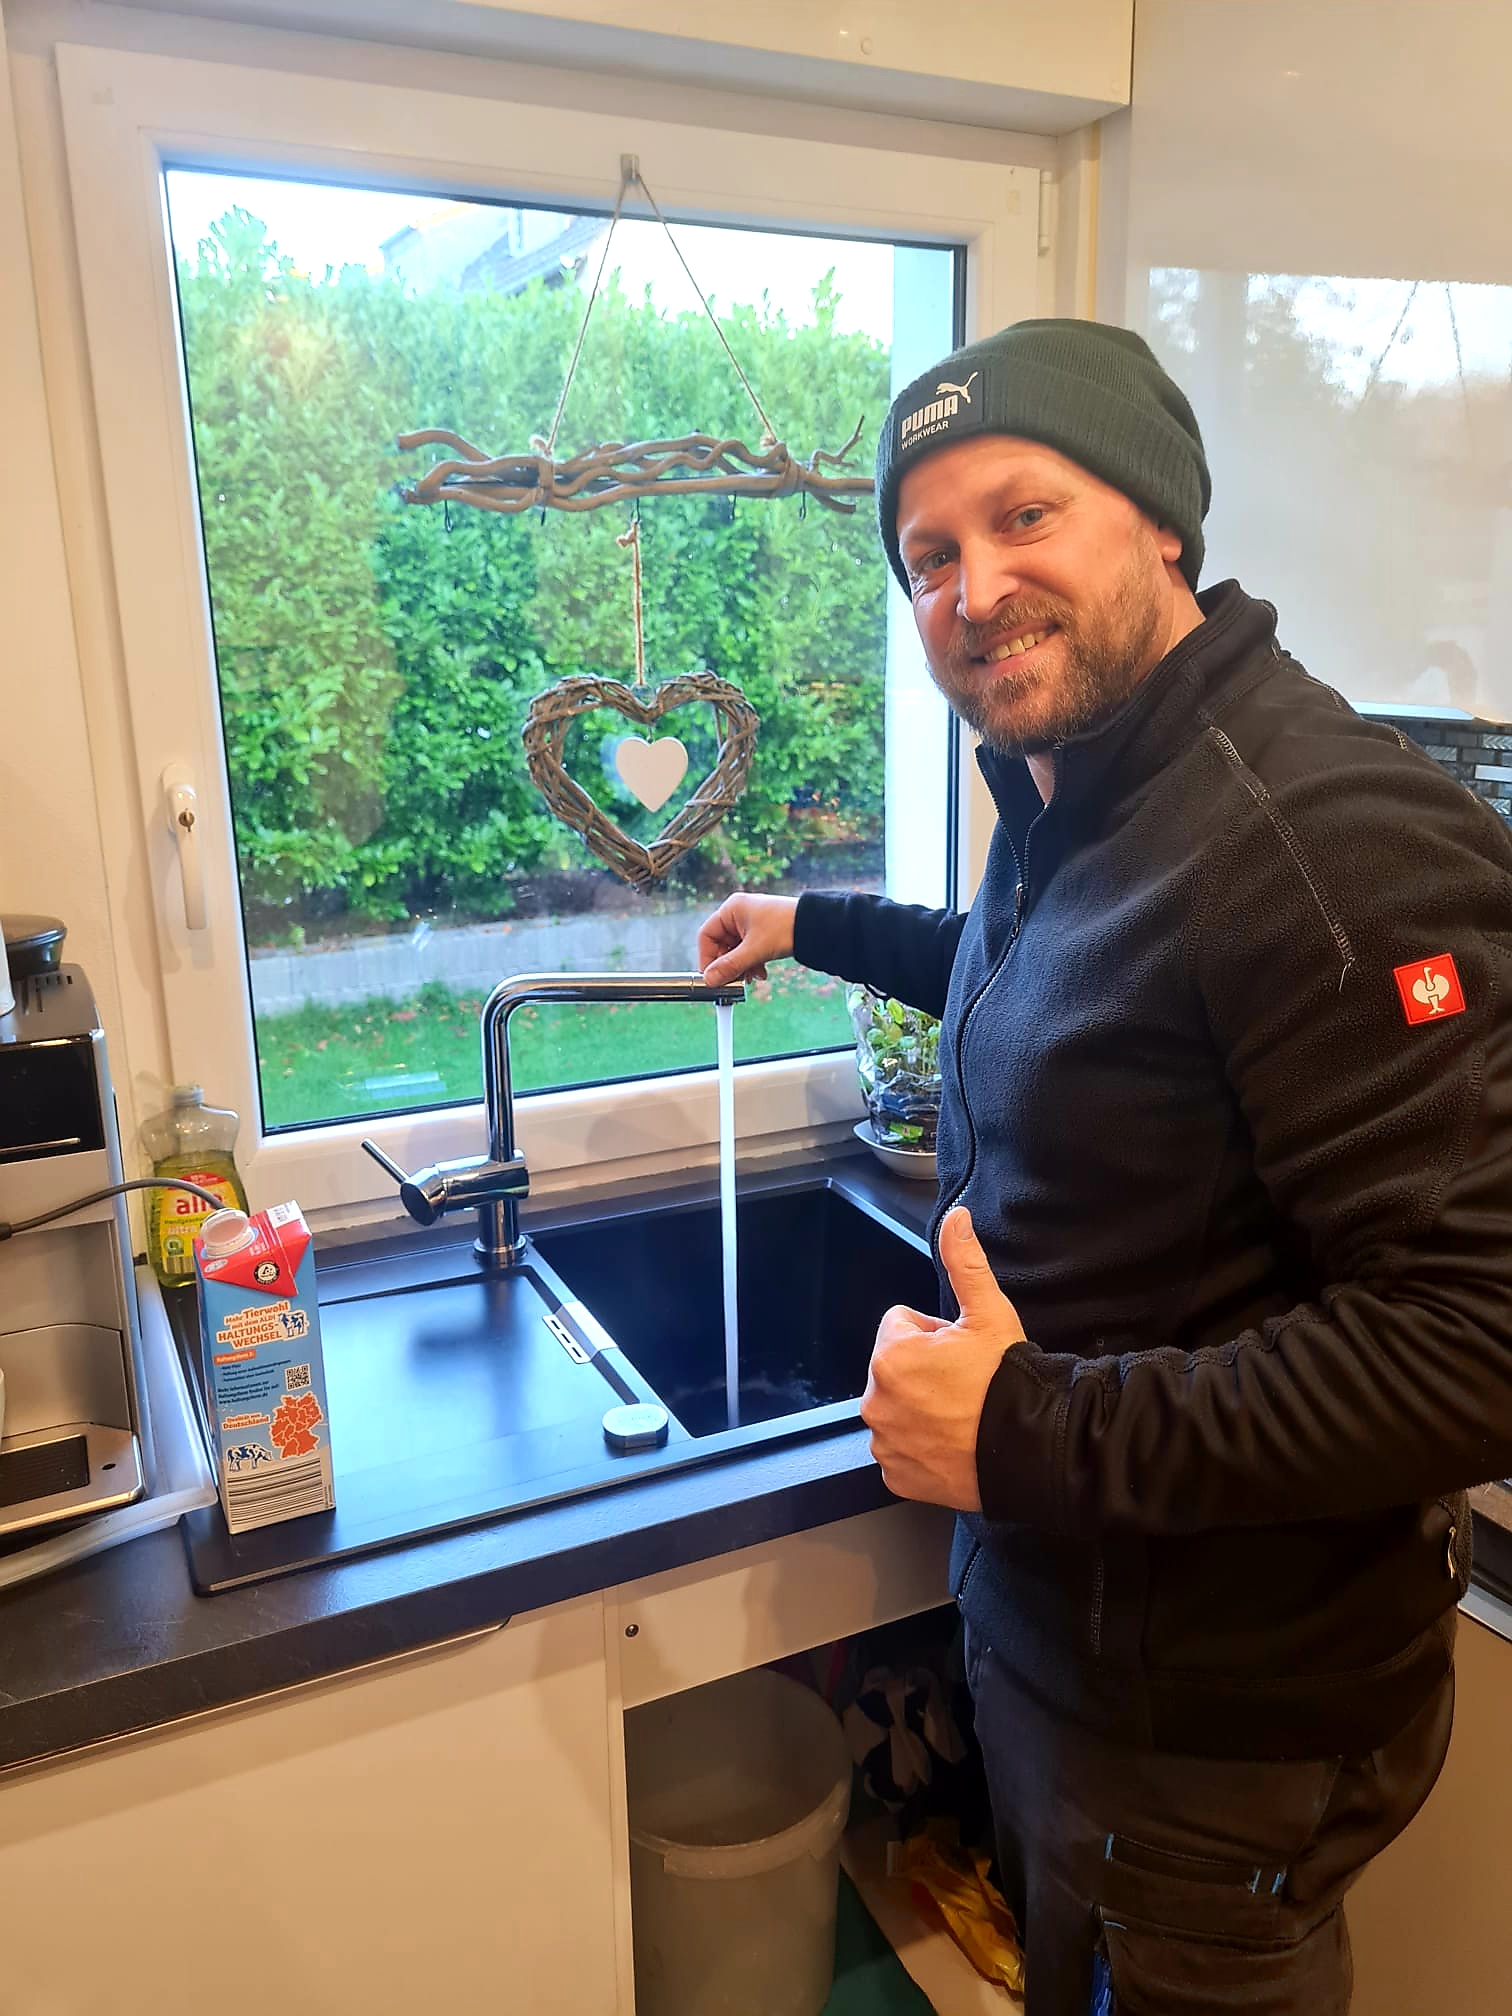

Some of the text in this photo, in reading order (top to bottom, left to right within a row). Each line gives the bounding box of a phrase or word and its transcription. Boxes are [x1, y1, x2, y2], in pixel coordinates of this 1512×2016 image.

[901, 394, 958, 440] PUMA
[901, 420, 949, 451] WORKWEAR
[243, 1302, 289, 1319] Tierwohl
[218, 1322, 279, 1341] HALTUNGS-
[232, 1331, 282, 1348] WECHSEL
[223, 1415, 269, 1429] Deutschland
